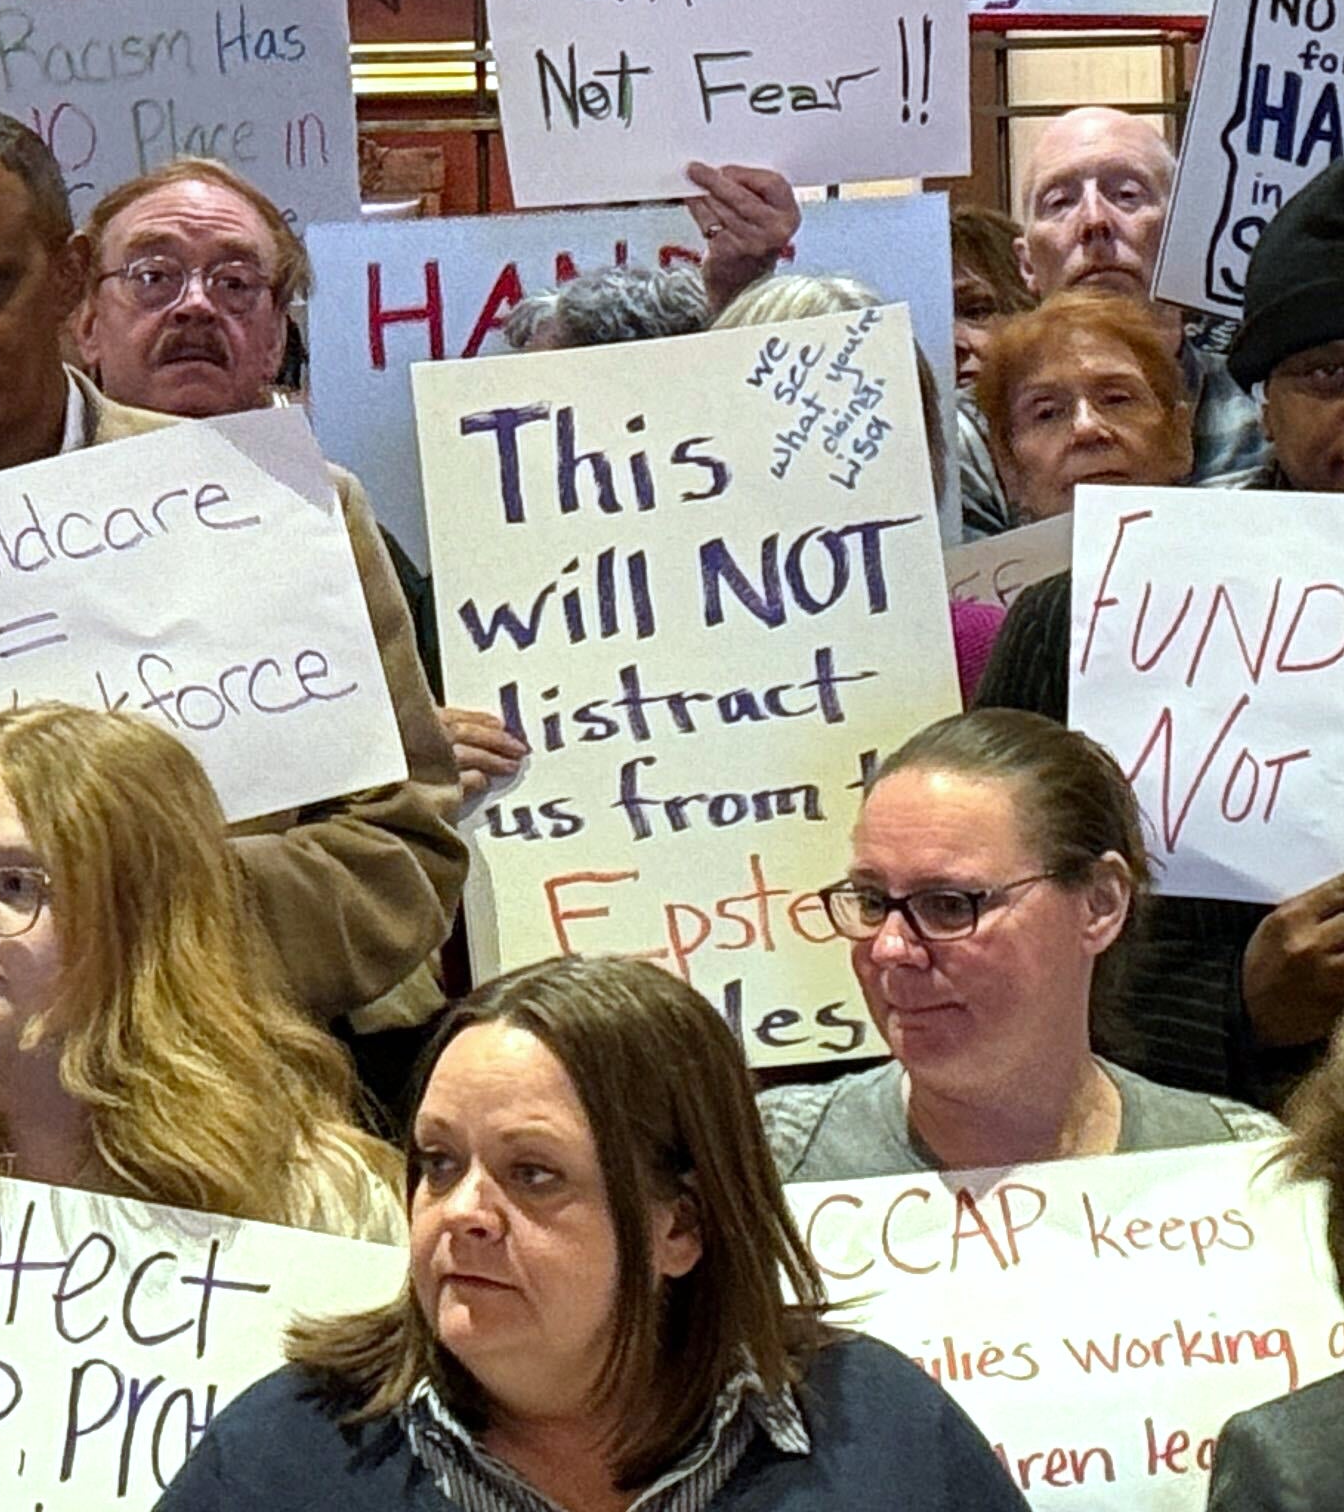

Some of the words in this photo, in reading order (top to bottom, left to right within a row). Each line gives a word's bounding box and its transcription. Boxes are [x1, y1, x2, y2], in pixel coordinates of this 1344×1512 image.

[214, 3, 306, 76] Has
[535, 42, 654, 131] Not
[32, 101, 97, 172] O
[773, 342, 827, 406] see
[458, 398, 733, 525] This
[769, 391, 827, 481] what
[457, 545, 656, 654] will
[698, 515, 925, 630] NOT
[483, 798, 586, 843] us
[609, 755, 829, 843] from
[1124, 693, 1313, 855] NOT
[544, 853, 837, 982] Epste
[723, 978, 867, 1054] les
[806, 1182, 1048, 1282] CCAP
[1081, 1191, 1257, 1267] keeps
